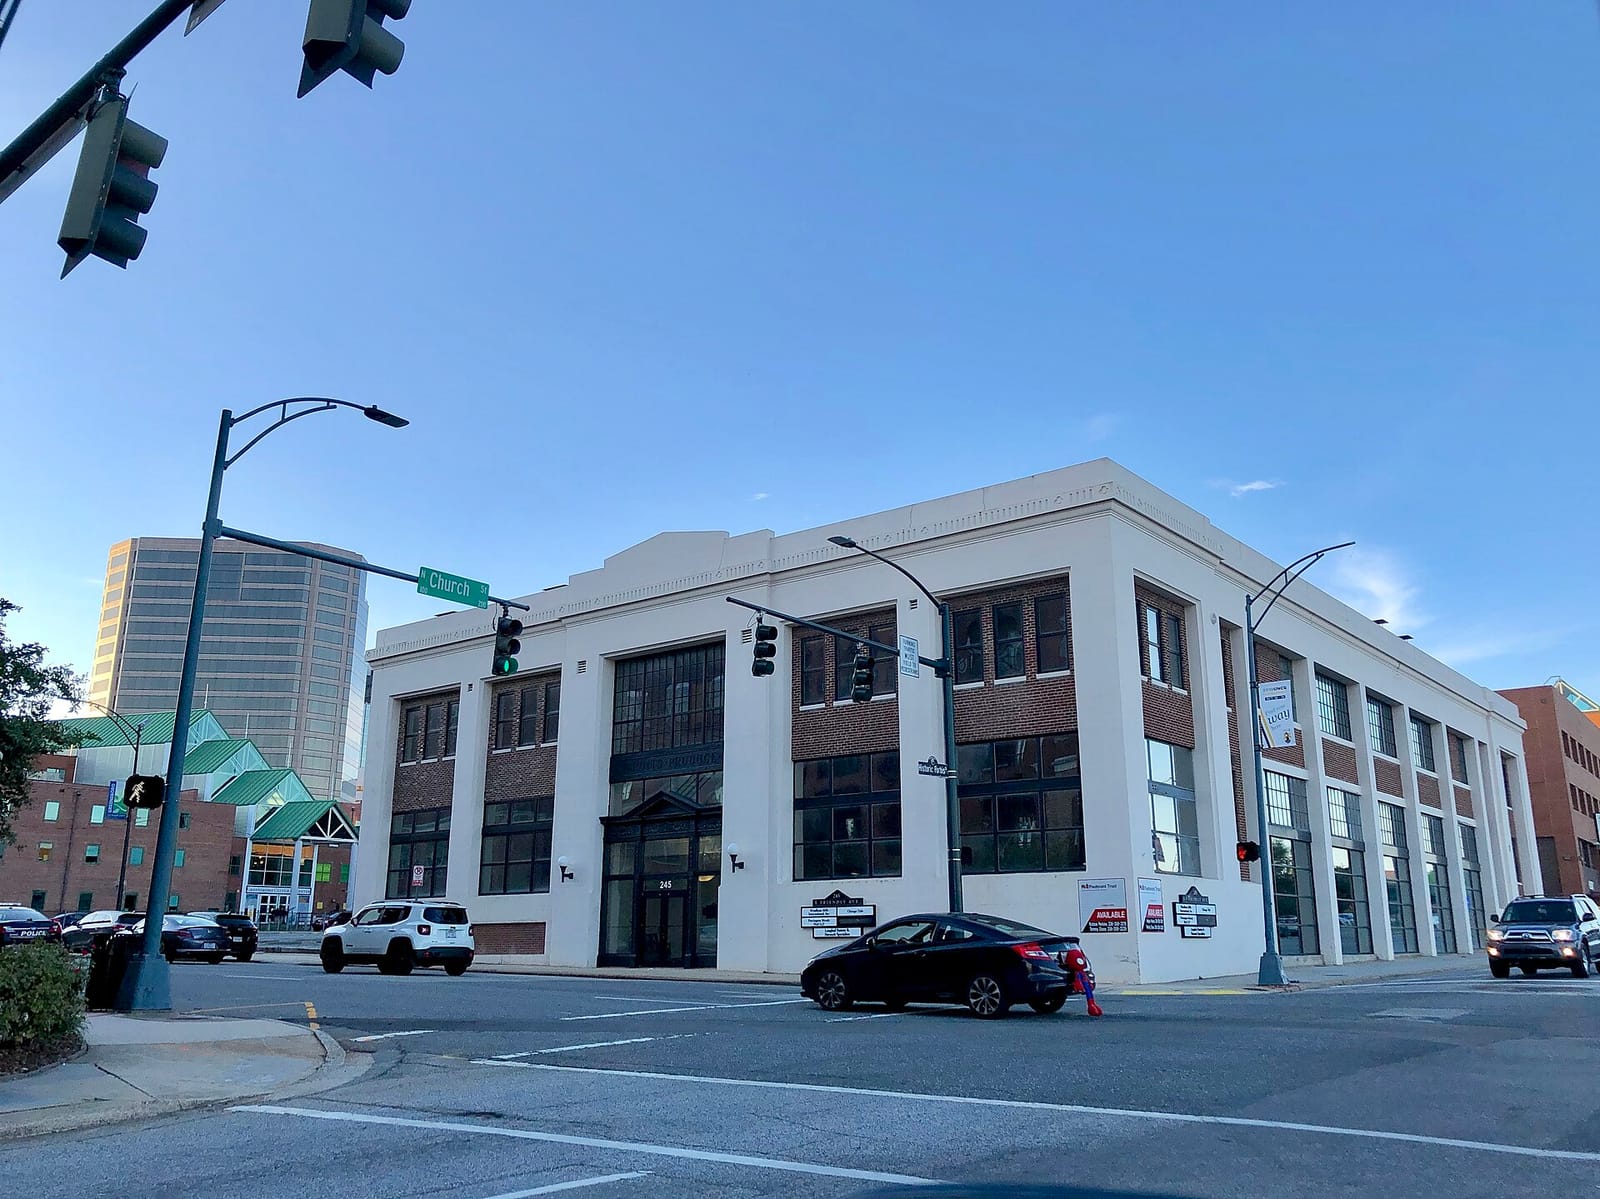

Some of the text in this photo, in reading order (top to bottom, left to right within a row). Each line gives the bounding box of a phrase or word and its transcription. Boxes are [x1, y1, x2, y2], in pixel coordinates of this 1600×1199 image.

[421, 569, 487, 597] N Church St
[1267, 709, 1290, 725] way
[660, 880, 672, 889] 245
[1096, 910, 1126, 919] AVAILABLE
